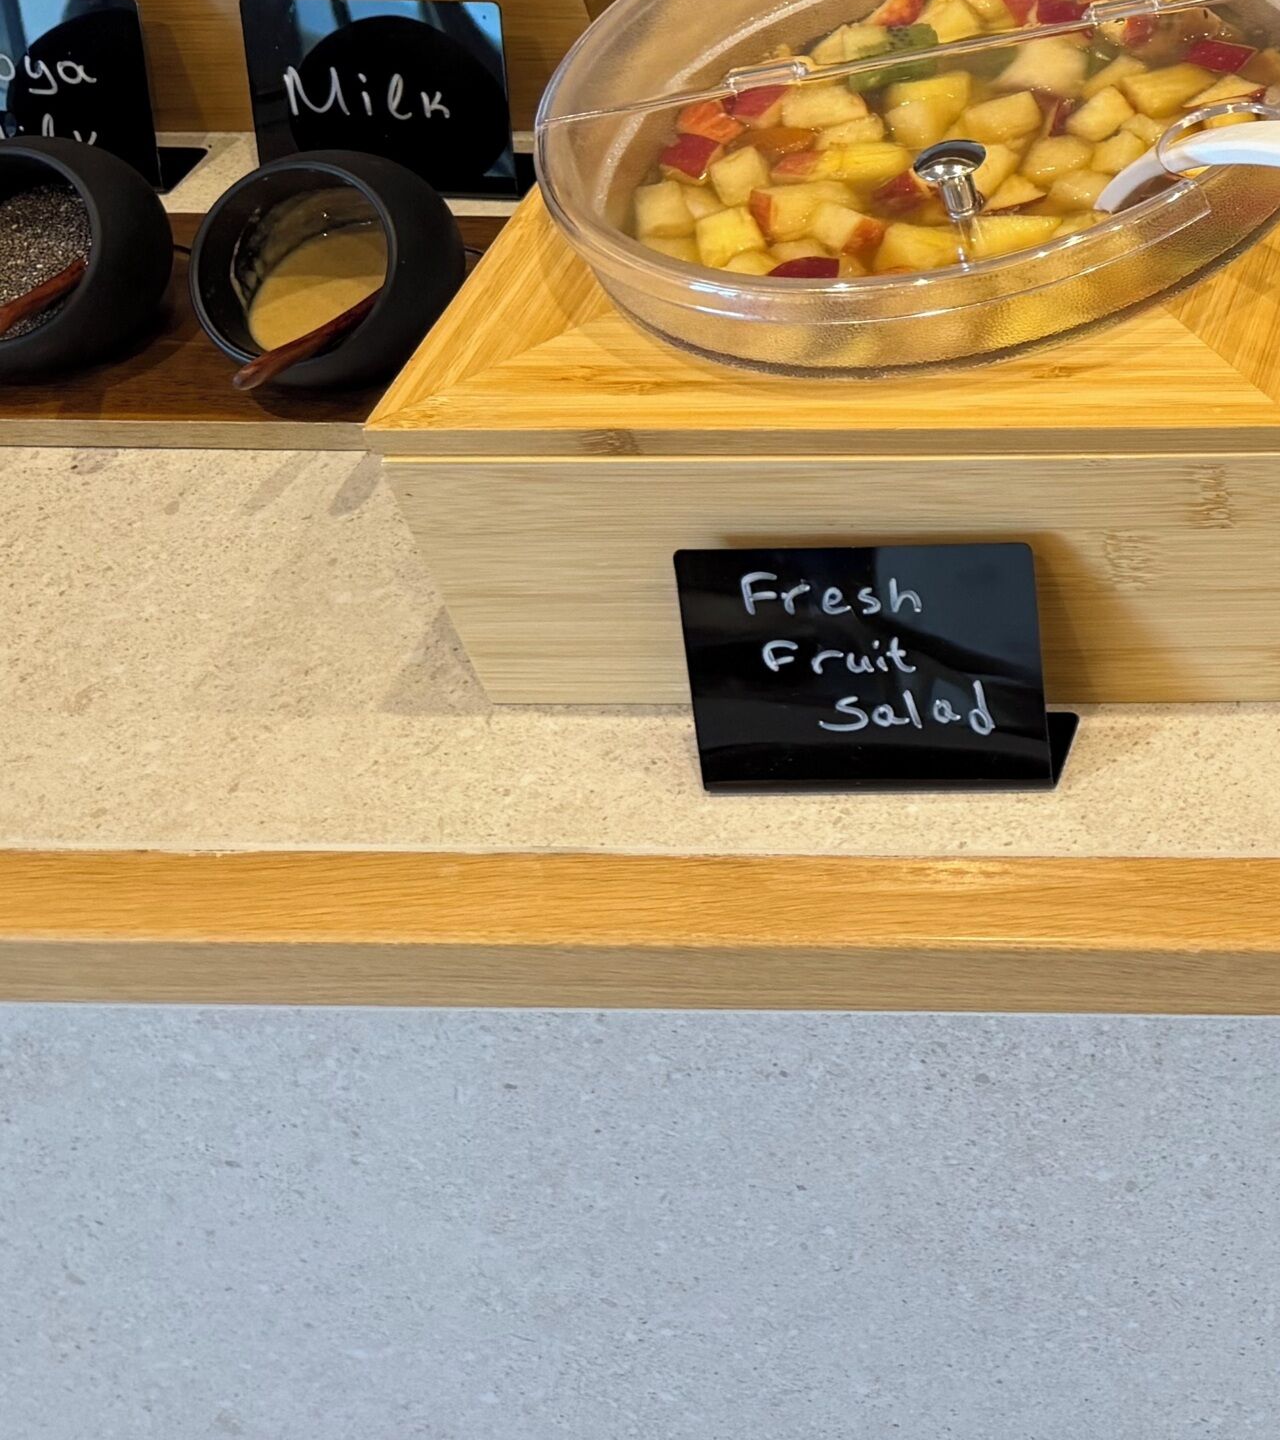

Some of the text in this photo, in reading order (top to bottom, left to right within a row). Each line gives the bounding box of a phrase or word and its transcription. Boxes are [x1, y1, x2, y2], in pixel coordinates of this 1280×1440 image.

[282, 65, 451, 120] Milk
[740, 570, 922, 616] Fresh
[761, 636, 917, 675] Fruit
[817, 679, 997, 736] Salad
